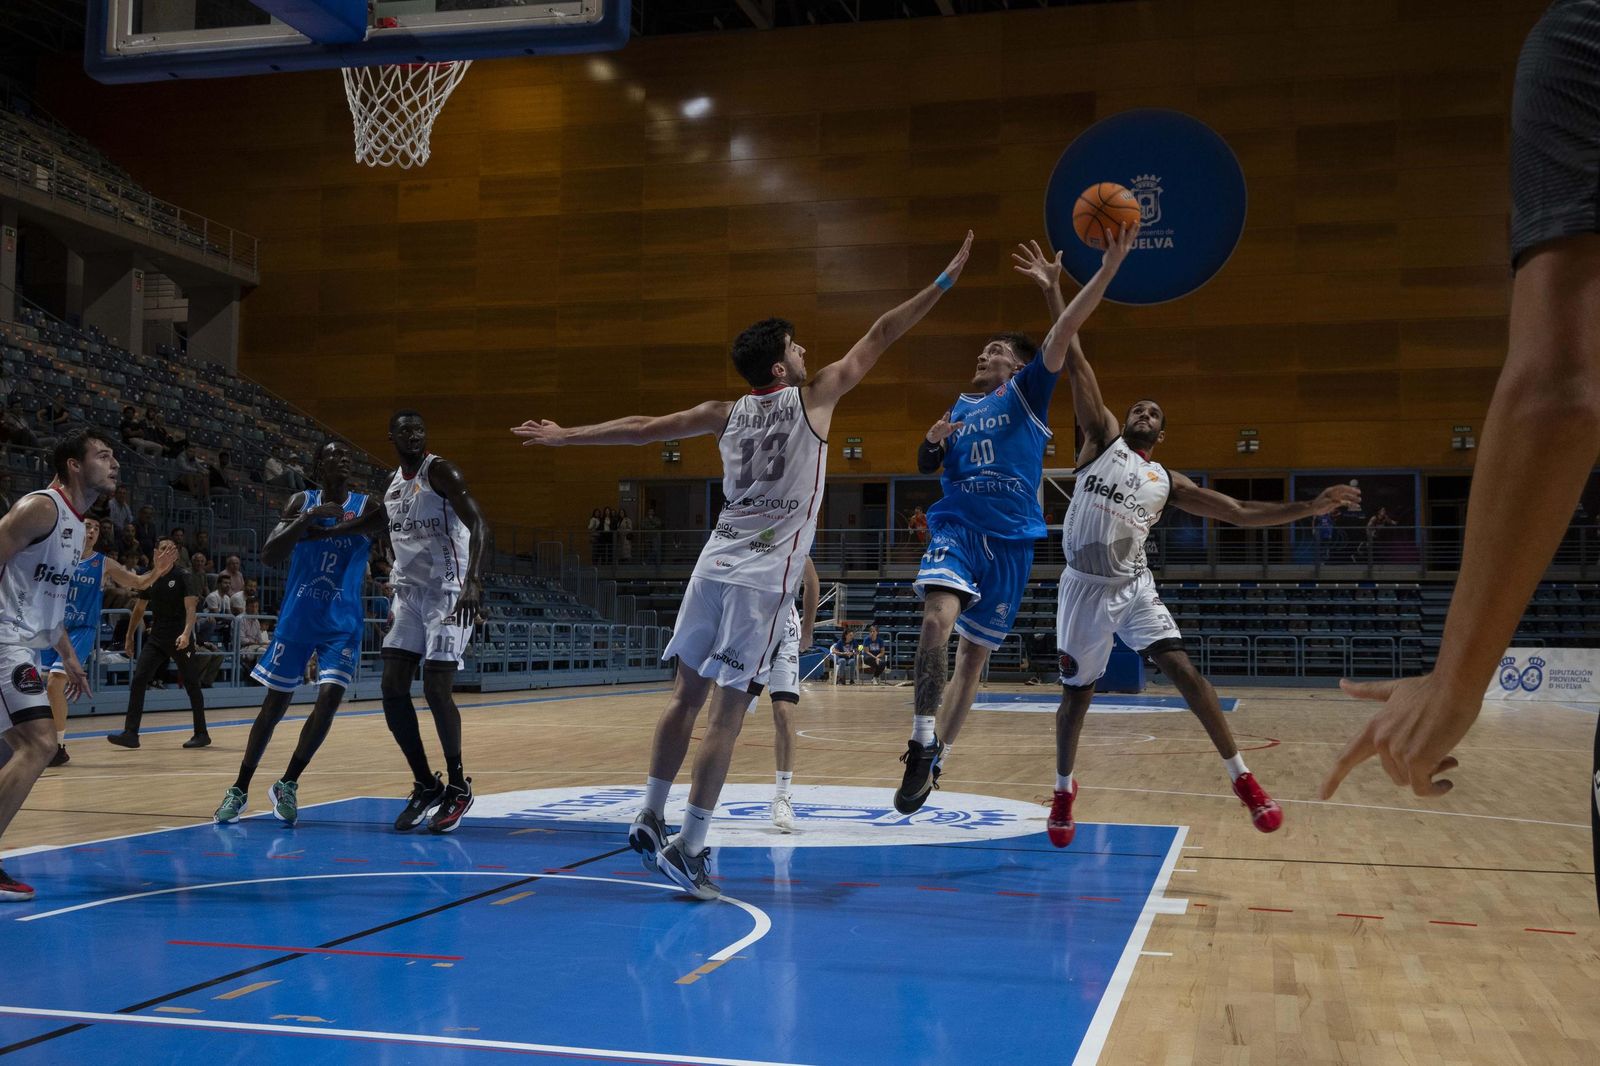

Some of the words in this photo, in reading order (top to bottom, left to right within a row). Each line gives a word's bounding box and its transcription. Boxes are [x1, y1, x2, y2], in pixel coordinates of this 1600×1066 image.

[1131, 237, 1174, 249] UELVA
[735, 432, 791, 489] 13
[970, 438, 995, 467] 40
[320, 551, 338, 574] 12
[270, 641, 285, 665] 12
[434, 635, 456, 653] 16
